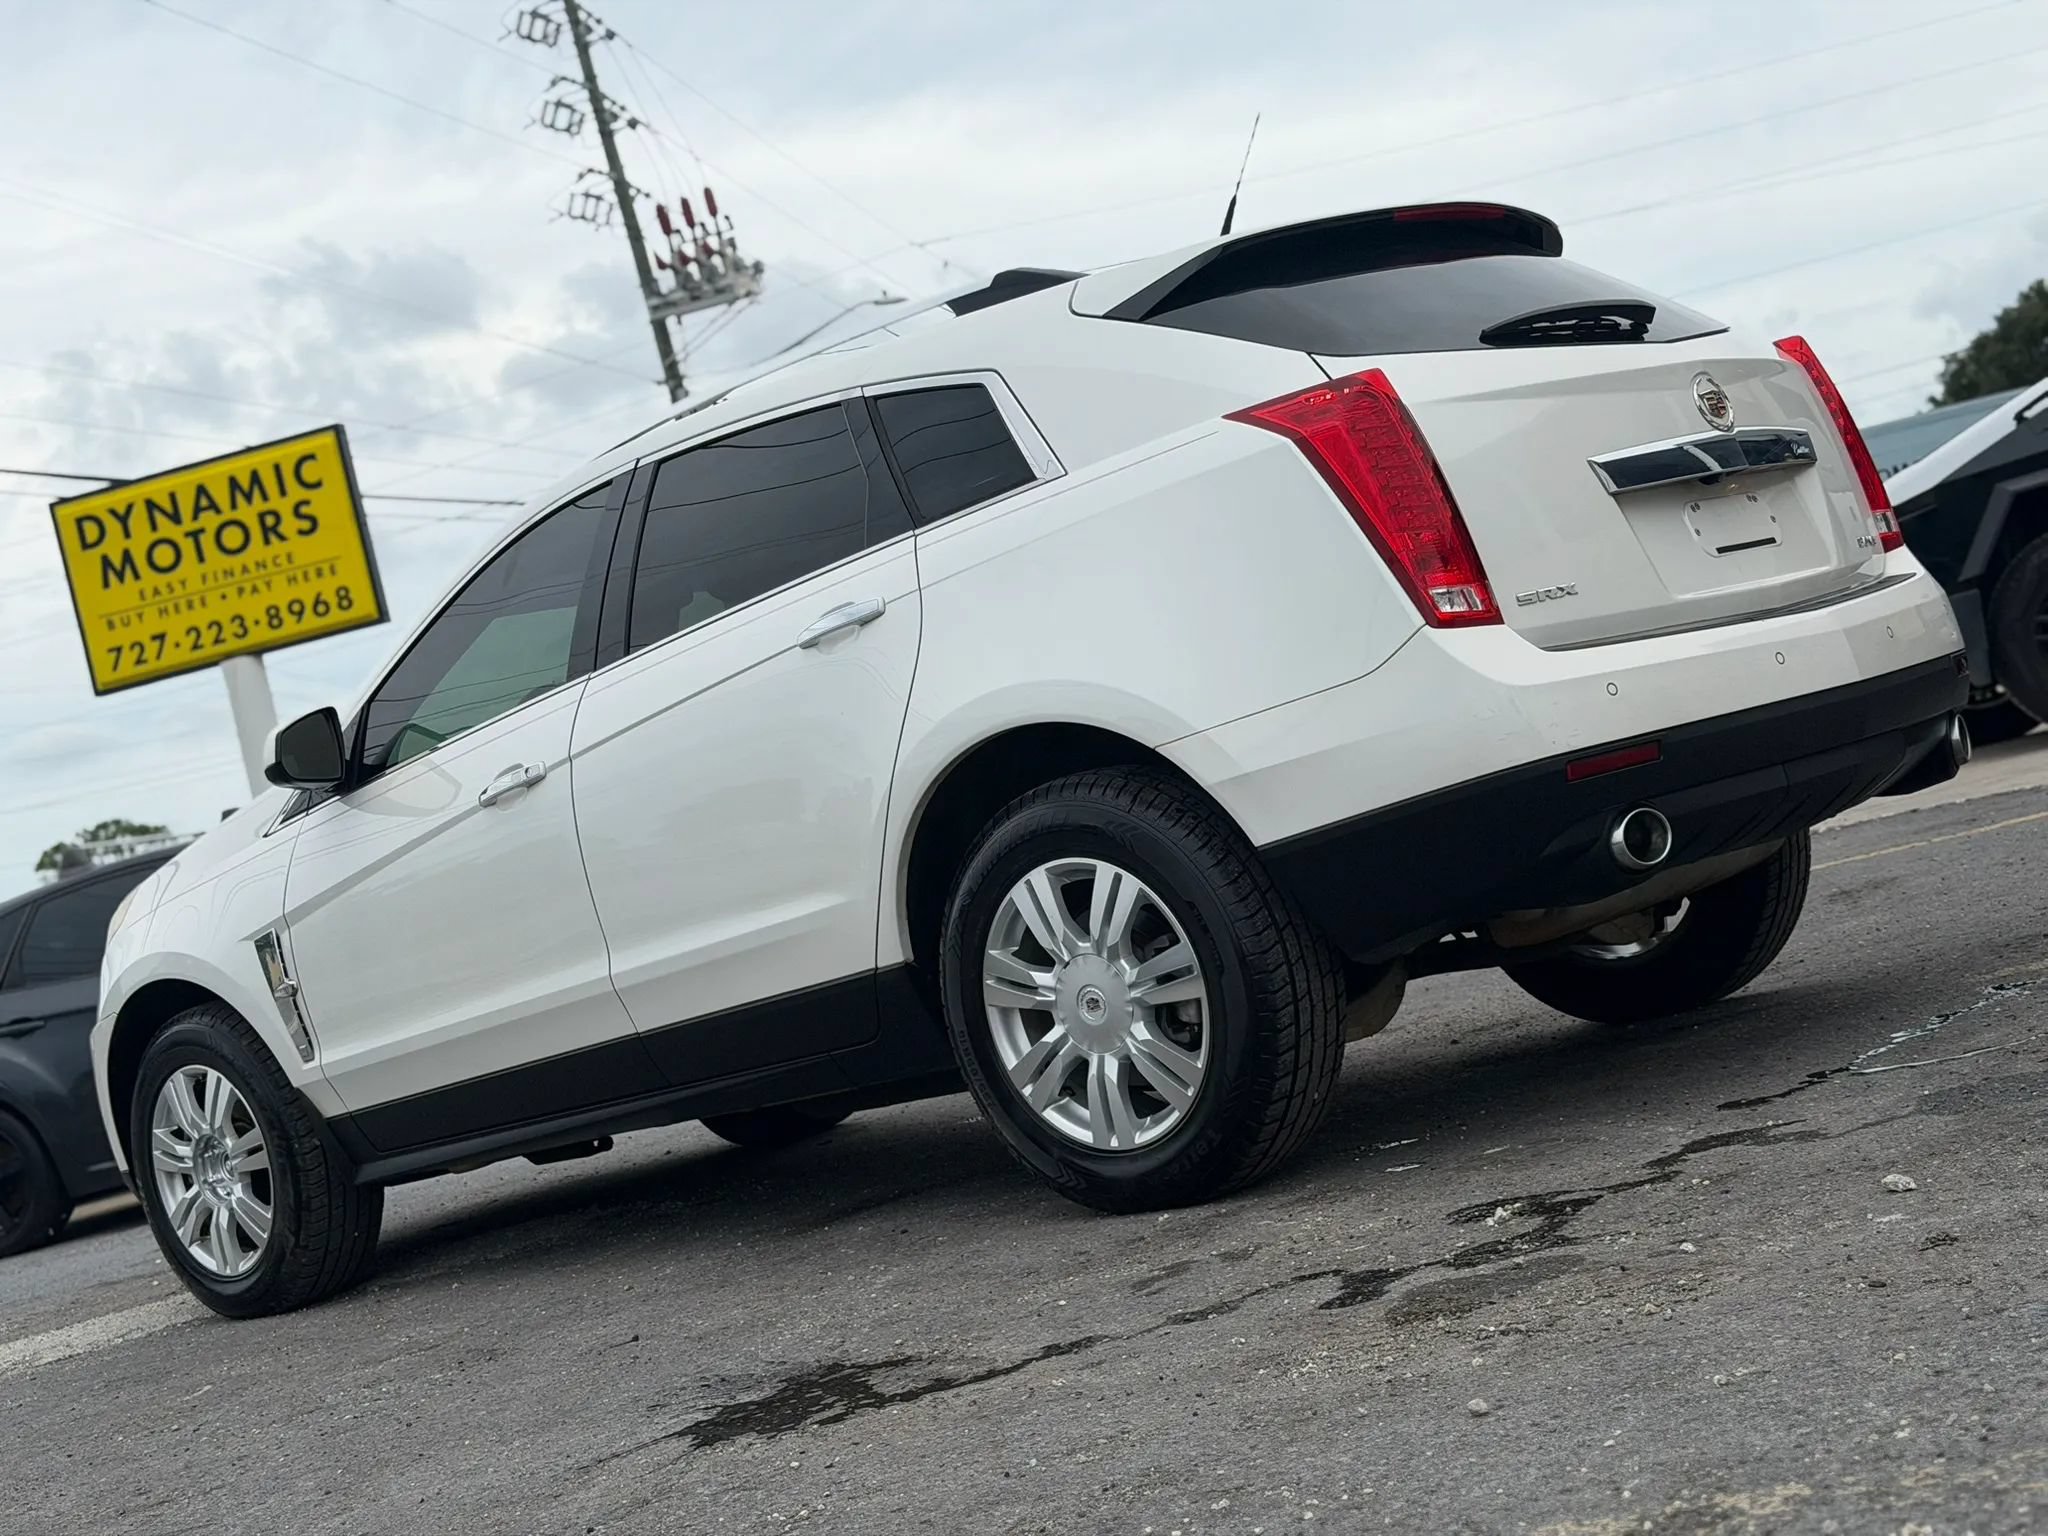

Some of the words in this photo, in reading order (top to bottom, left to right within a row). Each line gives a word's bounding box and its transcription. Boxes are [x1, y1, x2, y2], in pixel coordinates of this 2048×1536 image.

[74, 453, 324, 551] DYNAMIC
[100, 499, 320, 589] MOTORS
[139, 578, 189, 602] EASY
[201, 551, 296, 585] FINANCE
[106, 610, 145, 631] BUY
[159, 597, 207, 618] HERE
[236, 580, 274, 600] PAY
[286, 563, 338, 586] HERE
[1516, 582, 1578, 606] SRX
